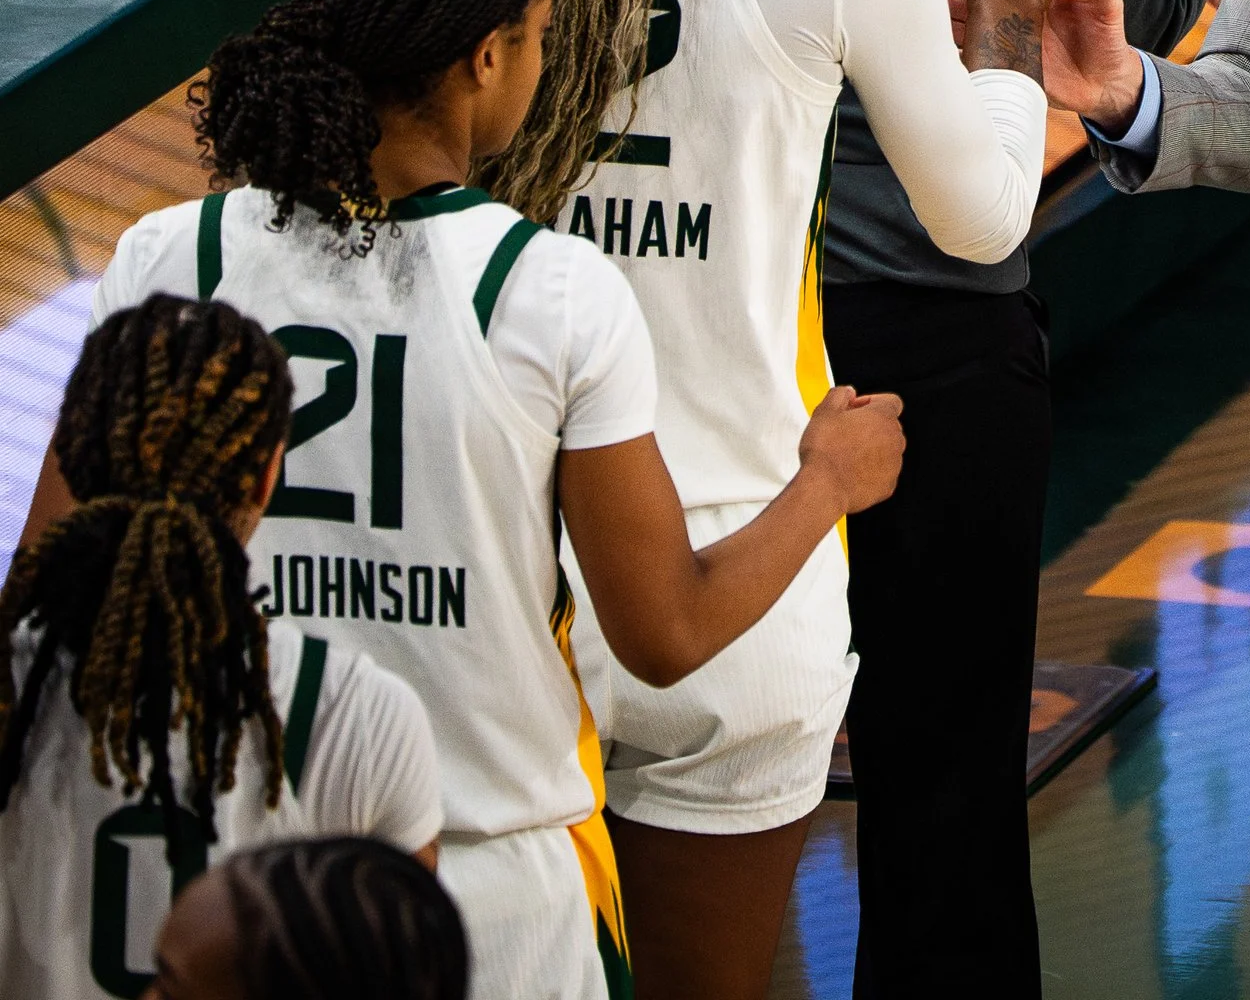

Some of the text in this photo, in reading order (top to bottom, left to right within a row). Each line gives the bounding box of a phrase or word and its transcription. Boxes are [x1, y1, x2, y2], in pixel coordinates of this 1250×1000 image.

[552, 195, 712, 261] AHAM
[261, 324, 407, 530] 21
[261, 554, 466, 628] JOHNSON
